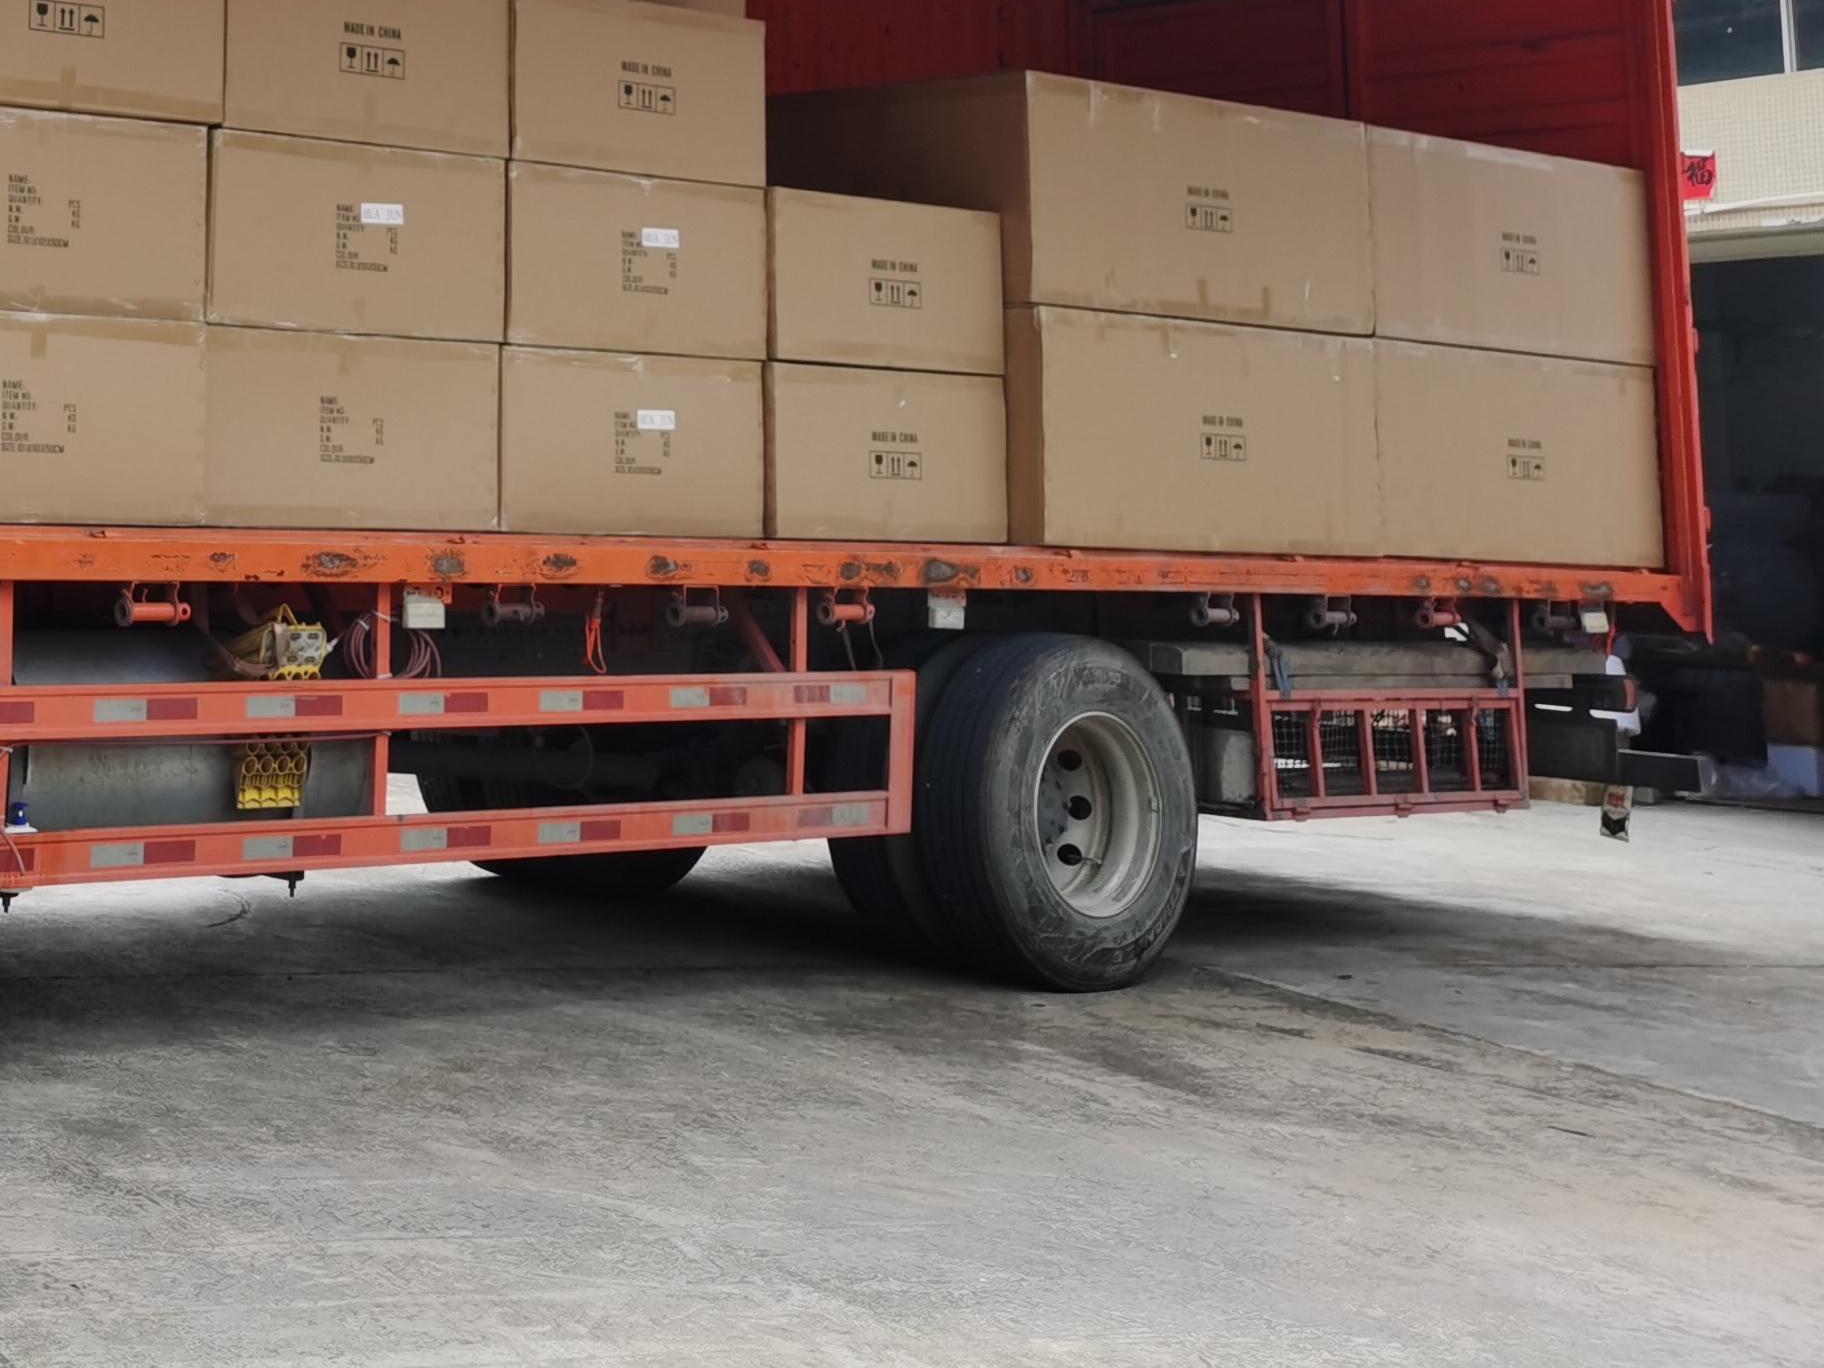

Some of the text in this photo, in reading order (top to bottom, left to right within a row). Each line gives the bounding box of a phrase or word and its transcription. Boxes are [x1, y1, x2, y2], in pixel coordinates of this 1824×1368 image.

[344, 21, 401, 40] MADE IN CHINA
